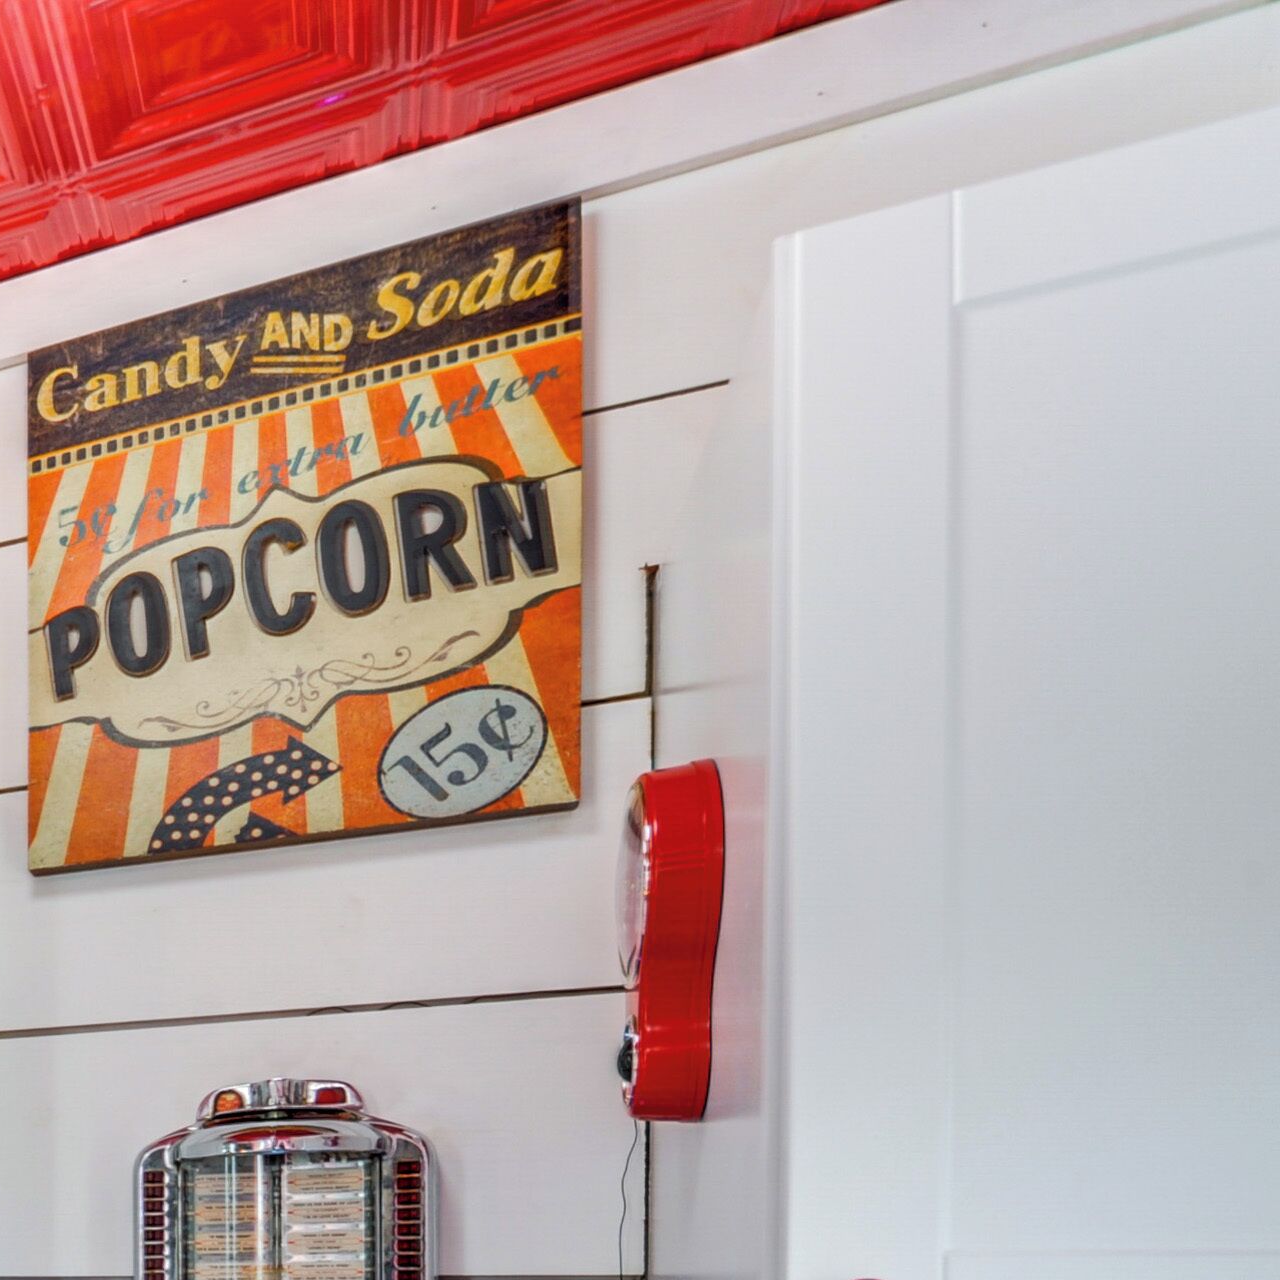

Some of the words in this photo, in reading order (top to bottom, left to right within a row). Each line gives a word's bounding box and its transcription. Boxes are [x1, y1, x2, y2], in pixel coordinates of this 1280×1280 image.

[36, 332, 247, 424] Candy
[260, 310, 355, 353] AND
[367, 246, 564, 342] Soda
[102, 486, 211, 556] for
[236, 429, 370, 494] extra
[397, 360, 564, 438] butter
[45, 478, 558, 704] POPCORN
[388, 697, 536, 802] 15¢
